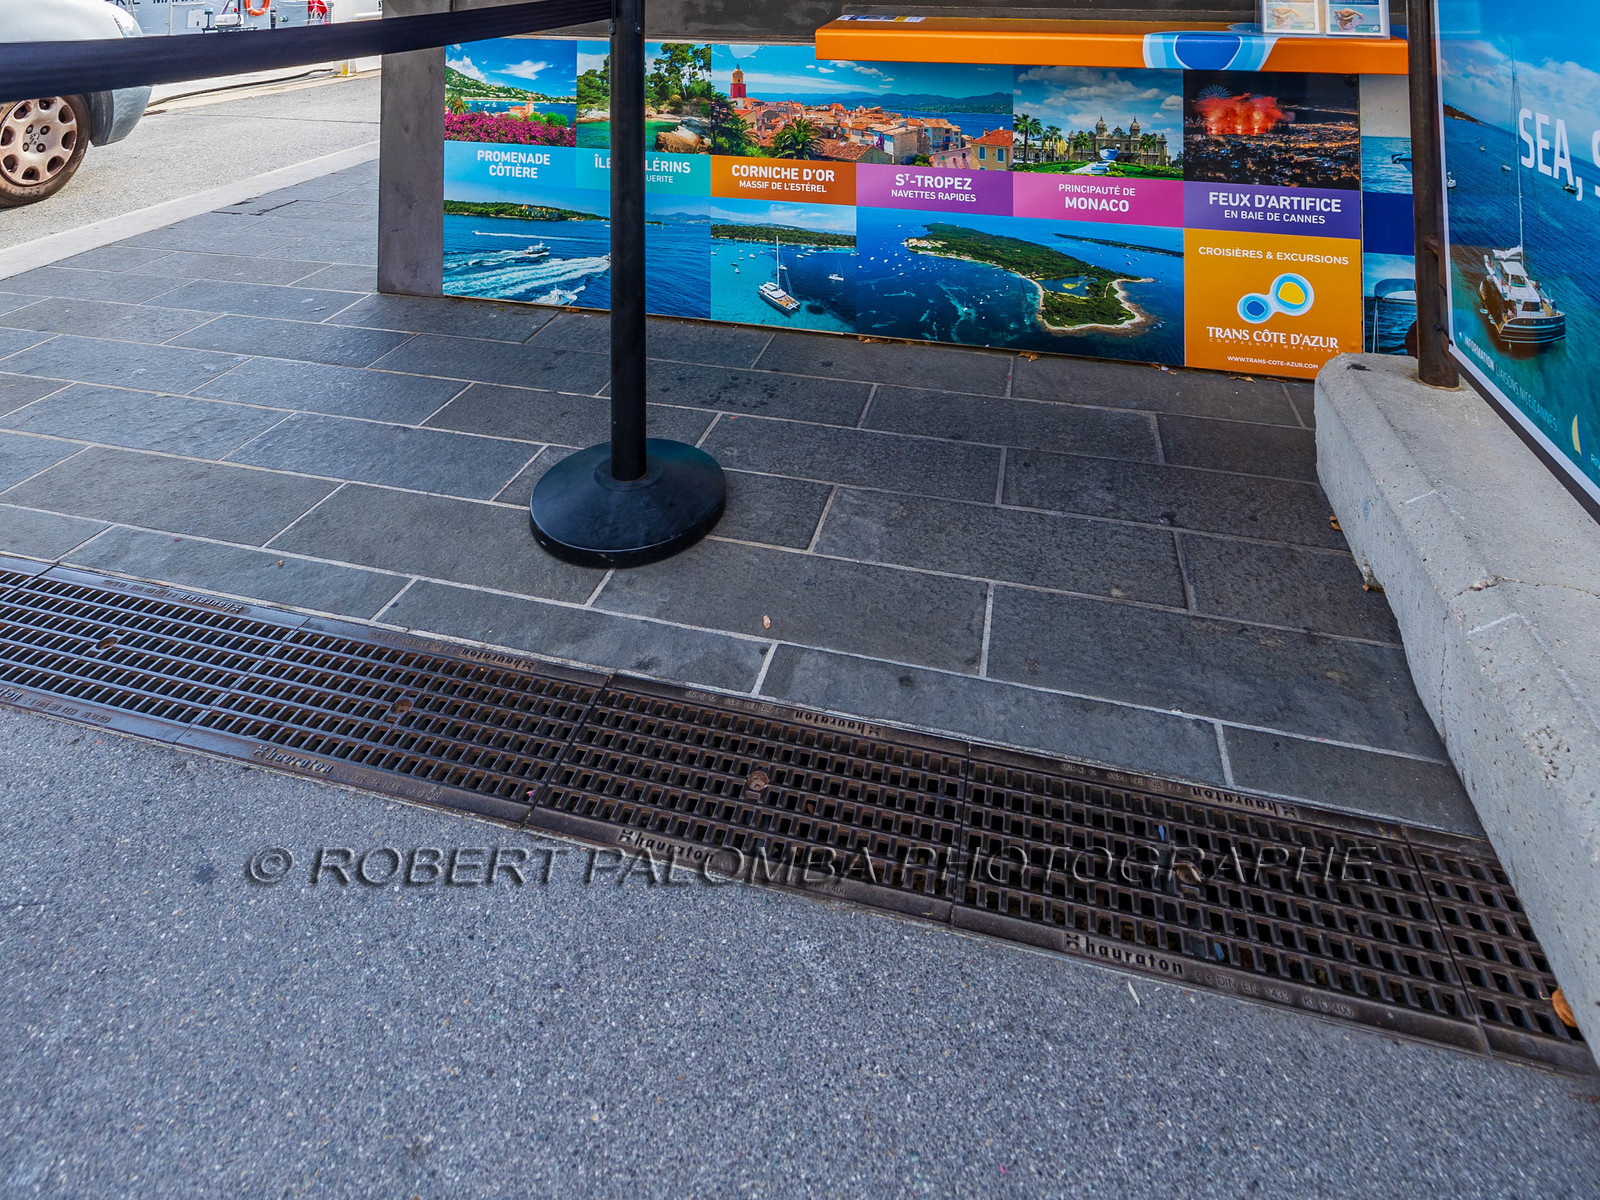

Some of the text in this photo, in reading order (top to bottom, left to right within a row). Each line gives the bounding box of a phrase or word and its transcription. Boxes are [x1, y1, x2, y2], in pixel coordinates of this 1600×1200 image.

[477, 149, 551, 166] PROMENADE
[1519, 108, 1583, 201] SEA,
[488, 161, 539, 179] CÔTIÈRE
[731, 164, 835, 182] CORNICHE D'OR
[739, 179, 827, 194] MASSIF DE L'ESTÉREL
[1058, 182, 1136, 197] PRINCIPAUTÉ DE
[891, 189, 977, 203] NAVETTES RAPIDES
[1064, 195, 1130, 213] MONACO
[1208, 191, 1342, 213] FEUX D'ARTIFICE
[1224, 209, 1326, 225] EN BAIE DE CANNES
[1198, 246, 1349, 265] CROISIÈRES & EXCURSIONS
[1206, 326, 1339, 349] TRANS CÔTE D'AZUR
[1209, 338, 1340, 354] COMPAGNIE MARITIME
[1227, 355, 1319, 369] WWW.TRANS-COTE-AZUR.COM
[794, 711, 865, 734] hauraton
[1192, 787, 1277, 814] hauraton
[1085, 937, 1183, 975] hauraton
